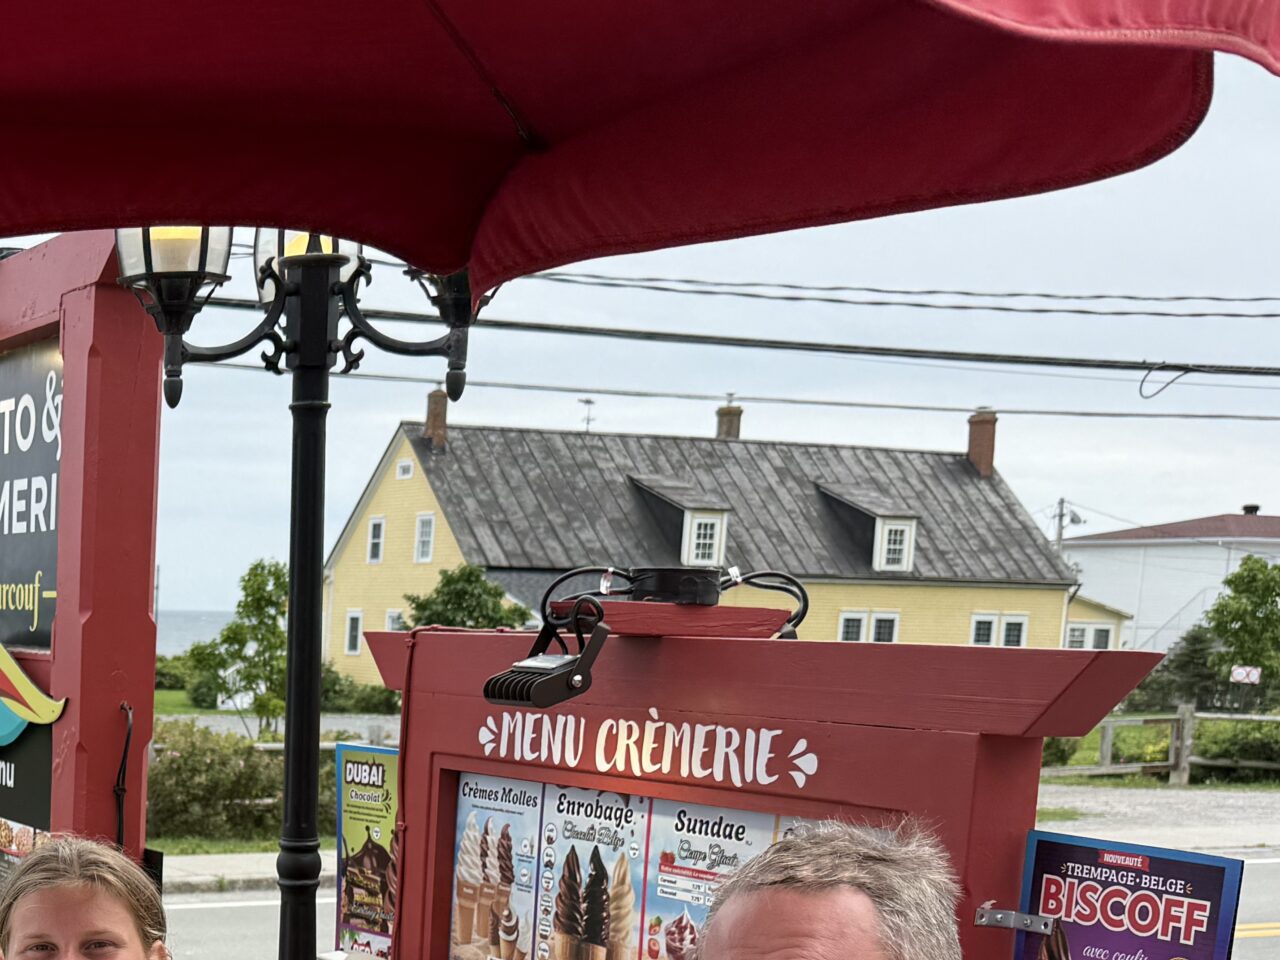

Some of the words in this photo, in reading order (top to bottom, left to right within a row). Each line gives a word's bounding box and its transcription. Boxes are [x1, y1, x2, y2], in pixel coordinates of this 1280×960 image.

[41, 370, 63, 461] &
[498, 710, 586, 768] MENU
[594, 707, 783, 788] CRÈMERIE
[345, 762, 383, 787] DUBAI
[350, 789, 380, 803] Chocolat
[462, 781, 499, 802] Crèmes
[500, 786, 538, 808] Molles
[556, 792, 634, 828] Enrobage
[675, 809, 746, 842] Sundae
[1103, 853, 1143, 867] NOUVEAUTÉ
[1066, 862, 1136, 886] TREMPAGE
[1141, 874, 1185, 894] BELGE
[1038, 873, 1211, 946] BISCOFF
[1082, 945, 1110, 960] avec
